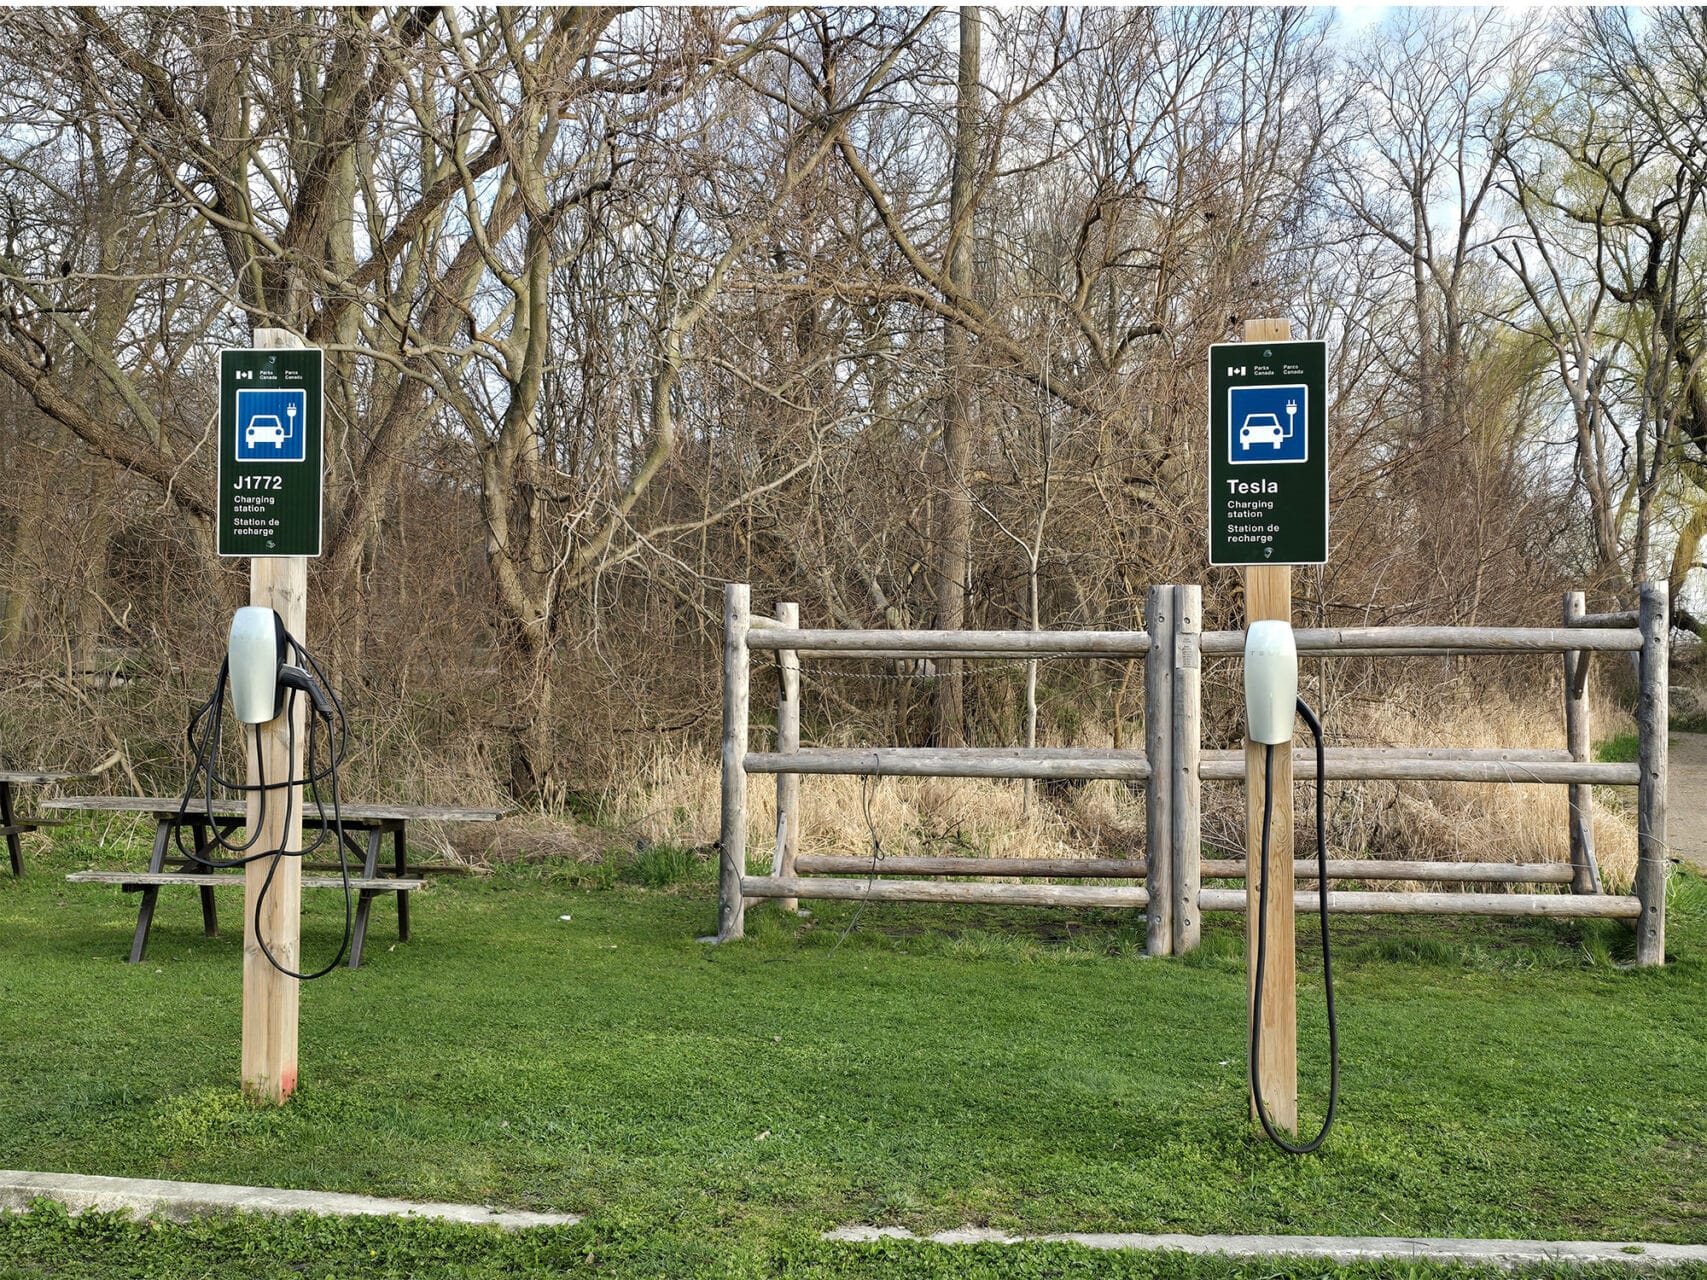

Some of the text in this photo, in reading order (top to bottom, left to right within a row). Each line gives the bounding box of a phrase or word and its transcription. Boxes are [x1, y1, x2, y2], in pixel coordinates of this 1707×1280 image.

[233, 475, 283, 490] J1772
[1226, 478, 1278, 494] Tesla
[233, 495, 275, 505] Charging
[1227, 500, 1274, 510] Charging
[233, 504, 266, 513] station
[1227, 510, 1263, 519] station
[233, 517, 280, 526] Station de
[233, 526, 274, 537] recharge
[1227, 524, 1280, 533] Station de
[1227, 534, 1273, 544] recharge
